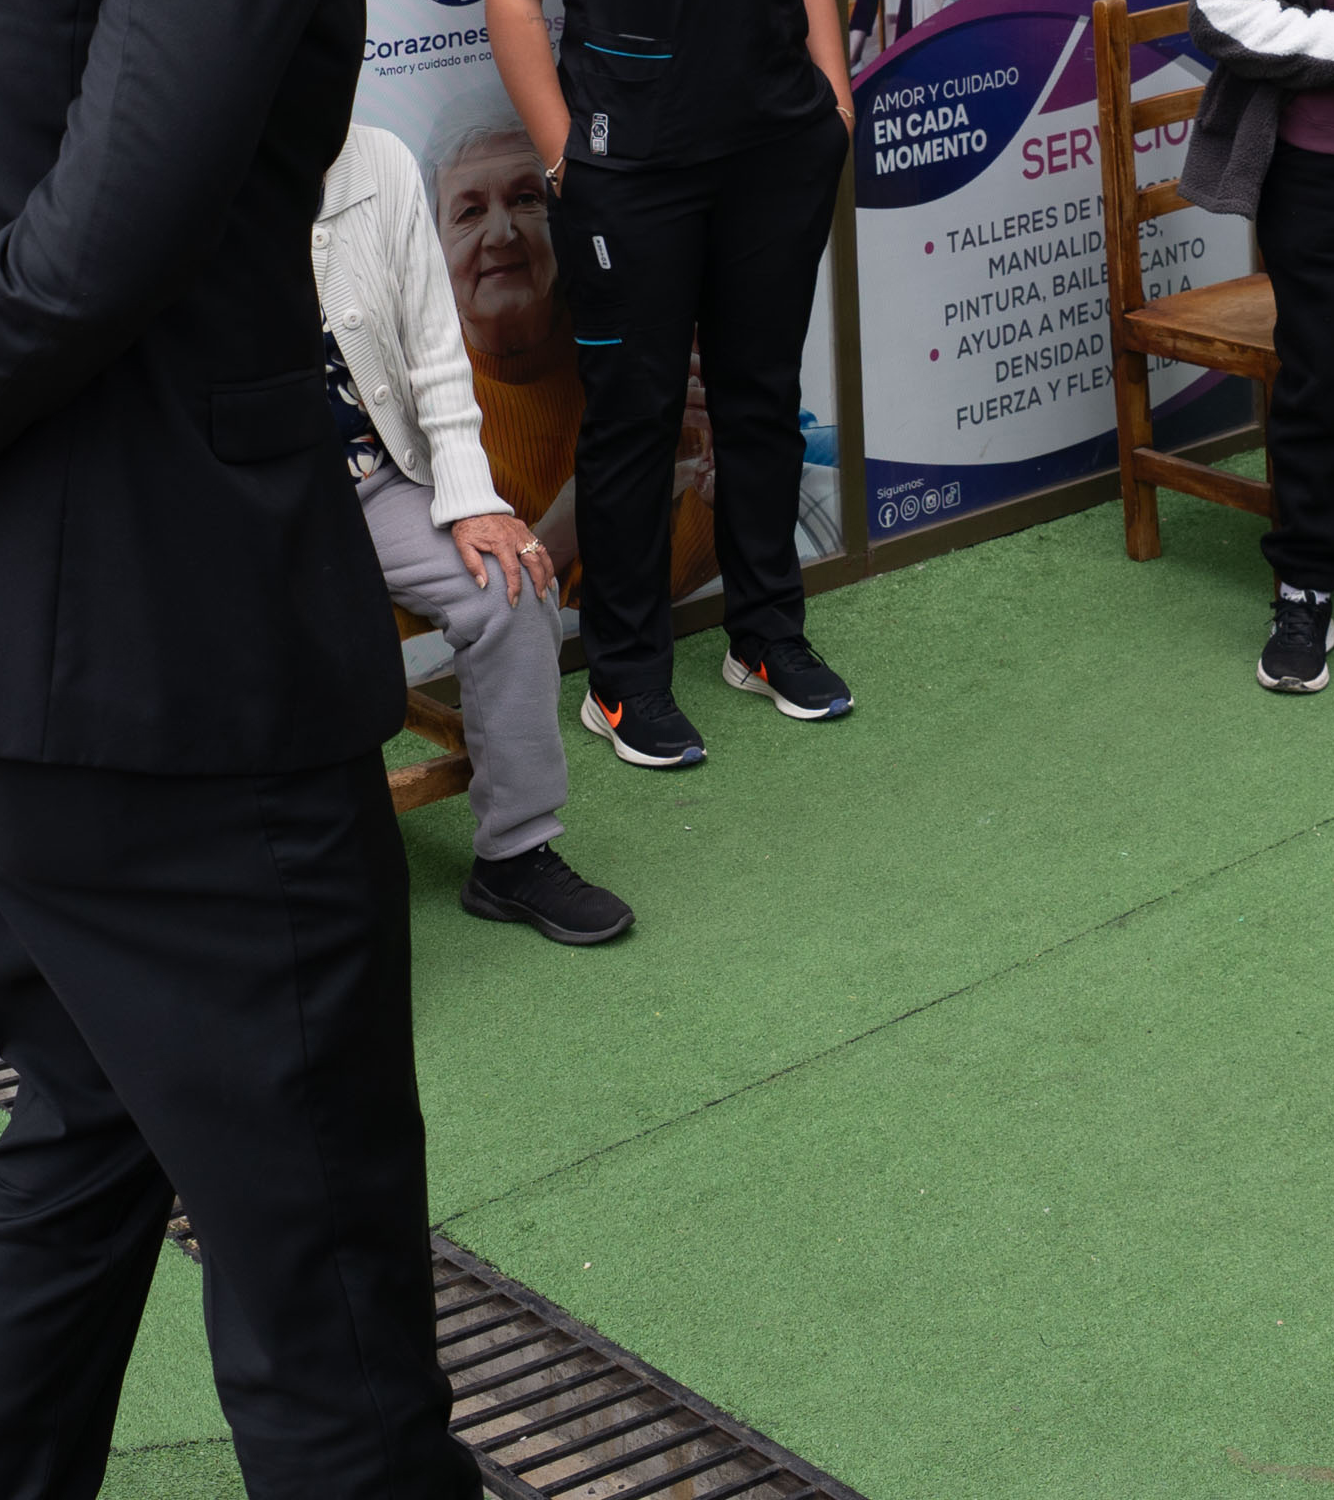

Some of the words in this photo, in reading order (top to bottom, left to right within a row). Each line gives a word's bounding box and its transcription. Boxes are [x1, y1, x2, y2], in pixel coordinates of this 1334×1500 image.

[363, 27, 491, 61] Corazones
[409, 64, 416, 75] y
[417, 53, 461, 71] cuidado
[463, 51, 477, 64] en
[872, 87, 925, 114] AMOR
[928, 83, 939, 101] Y
[943, 67, 1019, 98] CUIDADO
[874, 117, 902, 145] EN
[906, 103, 969, 137] CADA
[875, 129, 987, 175] MOMENTO
[947, 206, 1058, 253] TALLERES
[1064, 198, 1091, 225] DE
[945, 282, 1046, 326] PINTURA,
[957, 319, 1033, 359] AYUDA
[1039, 313, 1054, 336] A
[995, 333, 1104, 383] DENSIDAD
[956, 386, 1042, 430] FUERZA
[1048, 378, 1061, 401] Y
